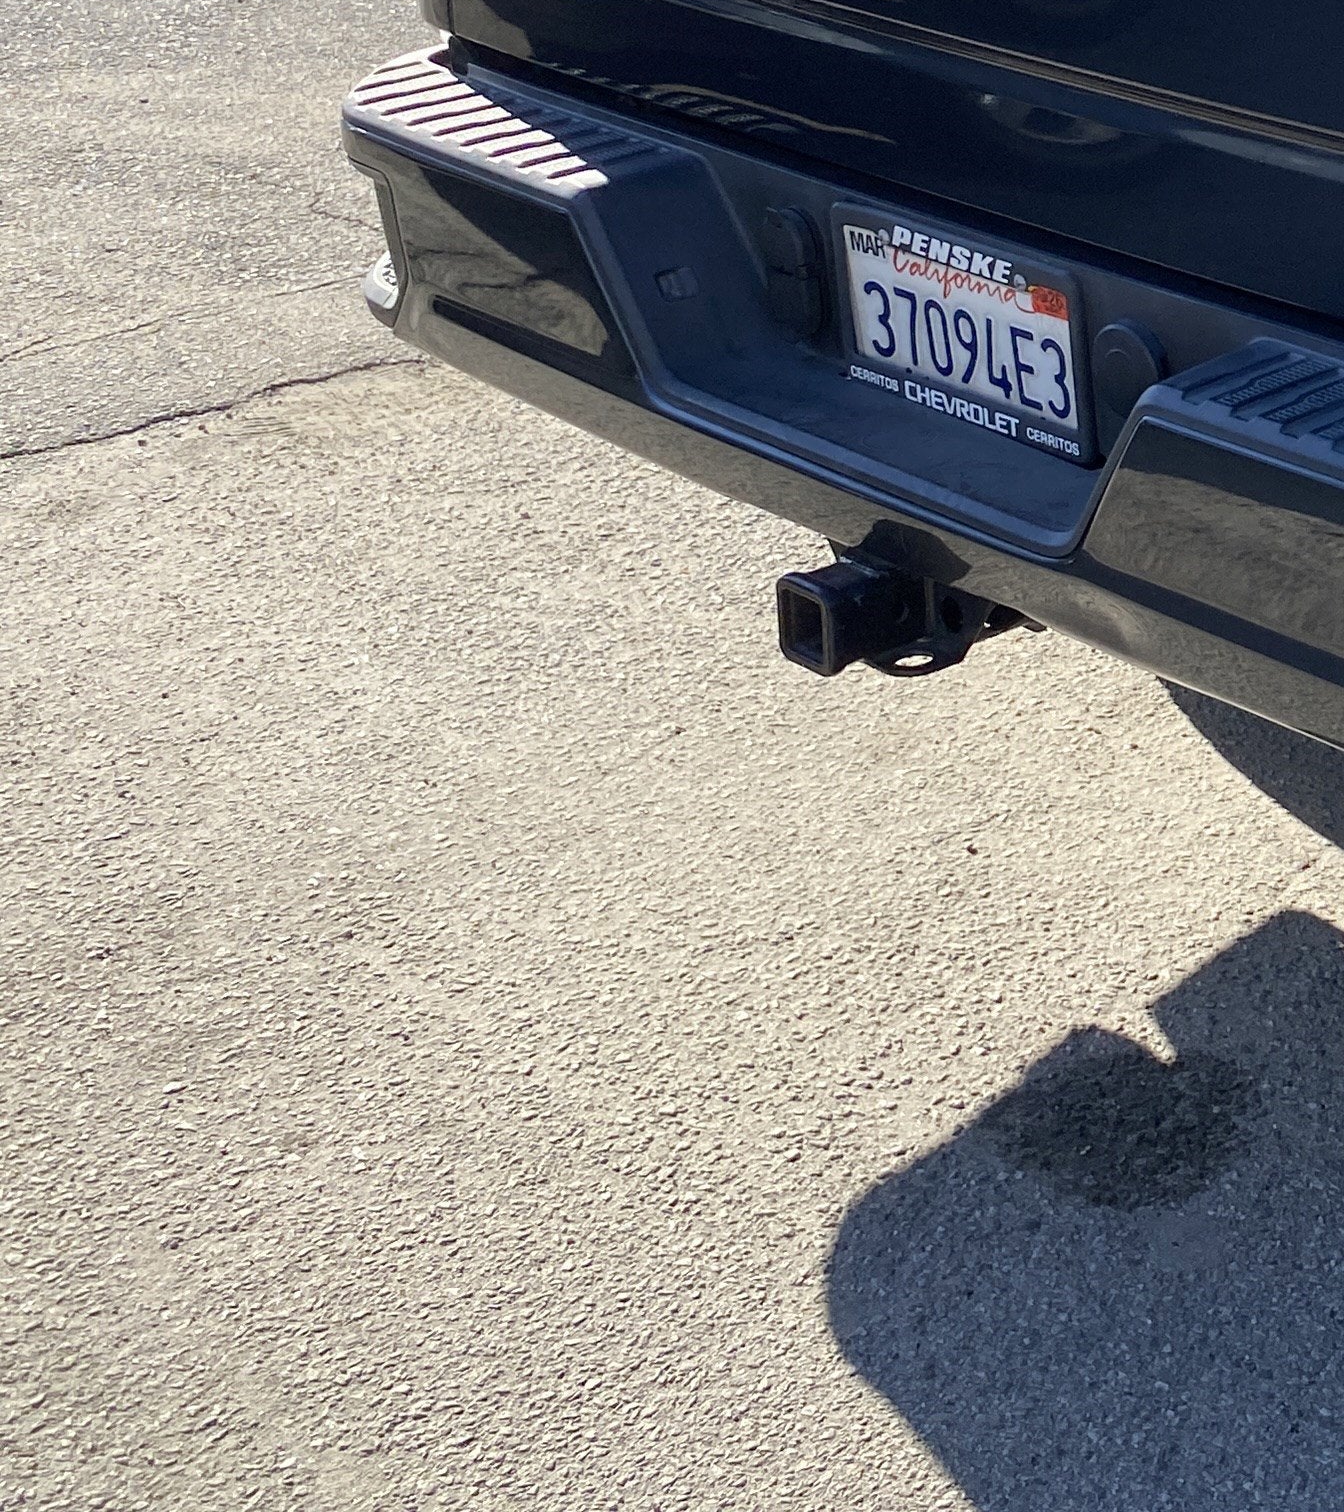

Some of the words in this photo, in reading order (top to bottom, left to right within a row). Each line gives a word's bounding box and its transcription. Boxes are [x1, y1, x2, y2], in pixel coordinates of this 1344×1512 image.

[849, 230, 886, 259] MAR
[891, 224, 1013, 284] PENSKE
[892, 247, 1017, 300] California
[863, 279, 1072, 420] 37094E3
[850, 364, 899, 392] CERRITOS
[904, 380, 1020, 438] CHEVROLET
[1026, 426, 1080, 457] CERRITOS
